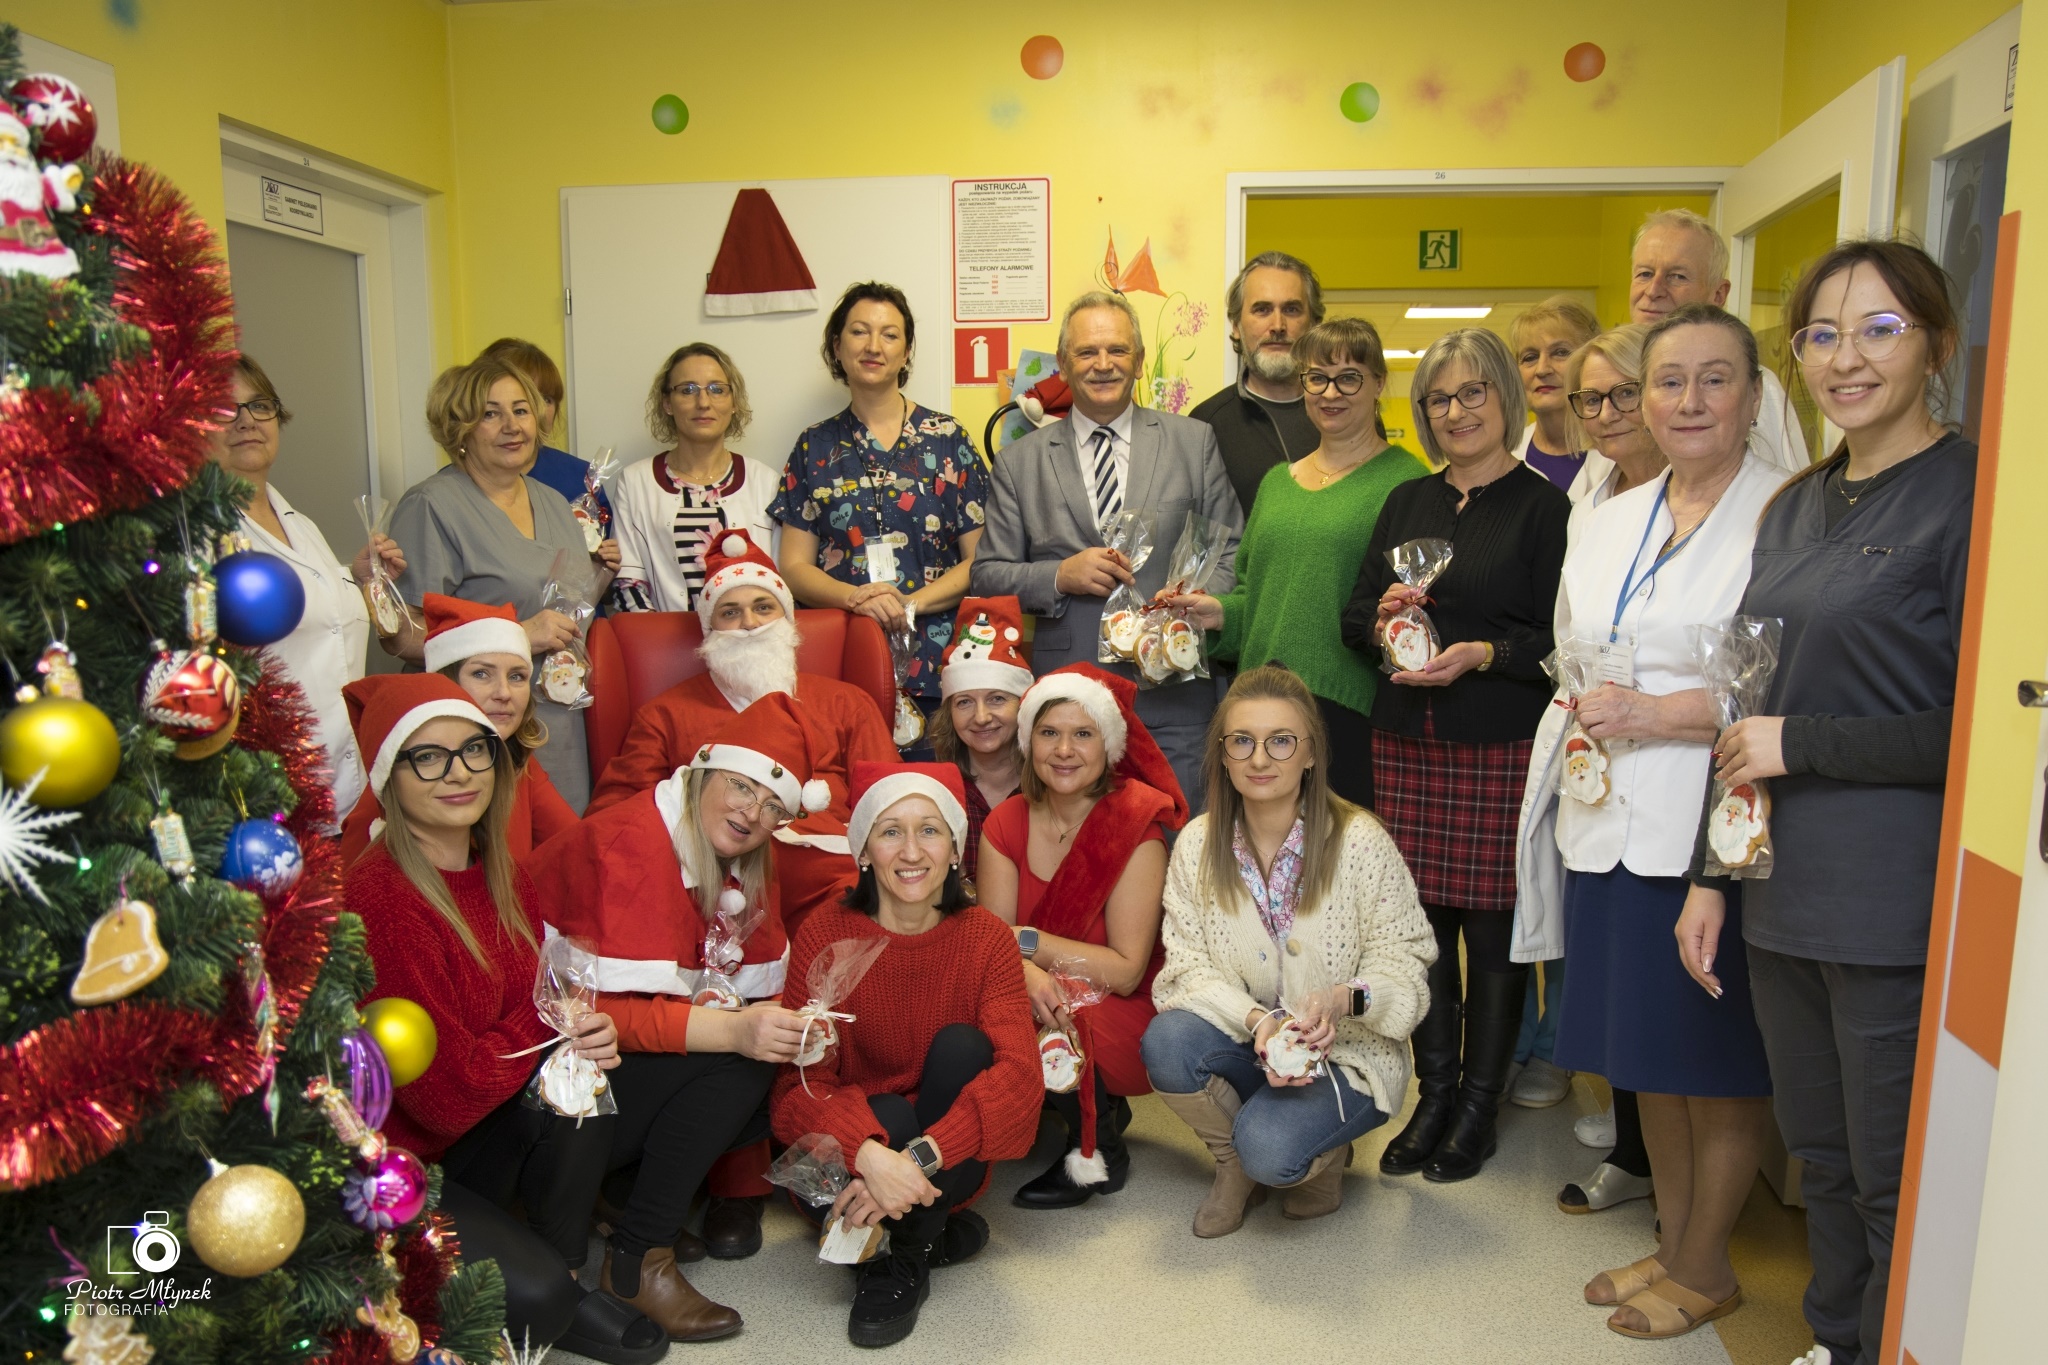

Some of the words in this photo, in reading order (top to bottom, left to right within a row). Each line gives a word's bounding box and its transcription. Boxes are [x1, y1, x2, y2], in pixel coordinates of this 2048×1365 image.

[1435, 171, 1446, 180] 26
[974, 182, 1027, 191] INSTRUKCJA
[831, 511, 850, 526] SMILE
